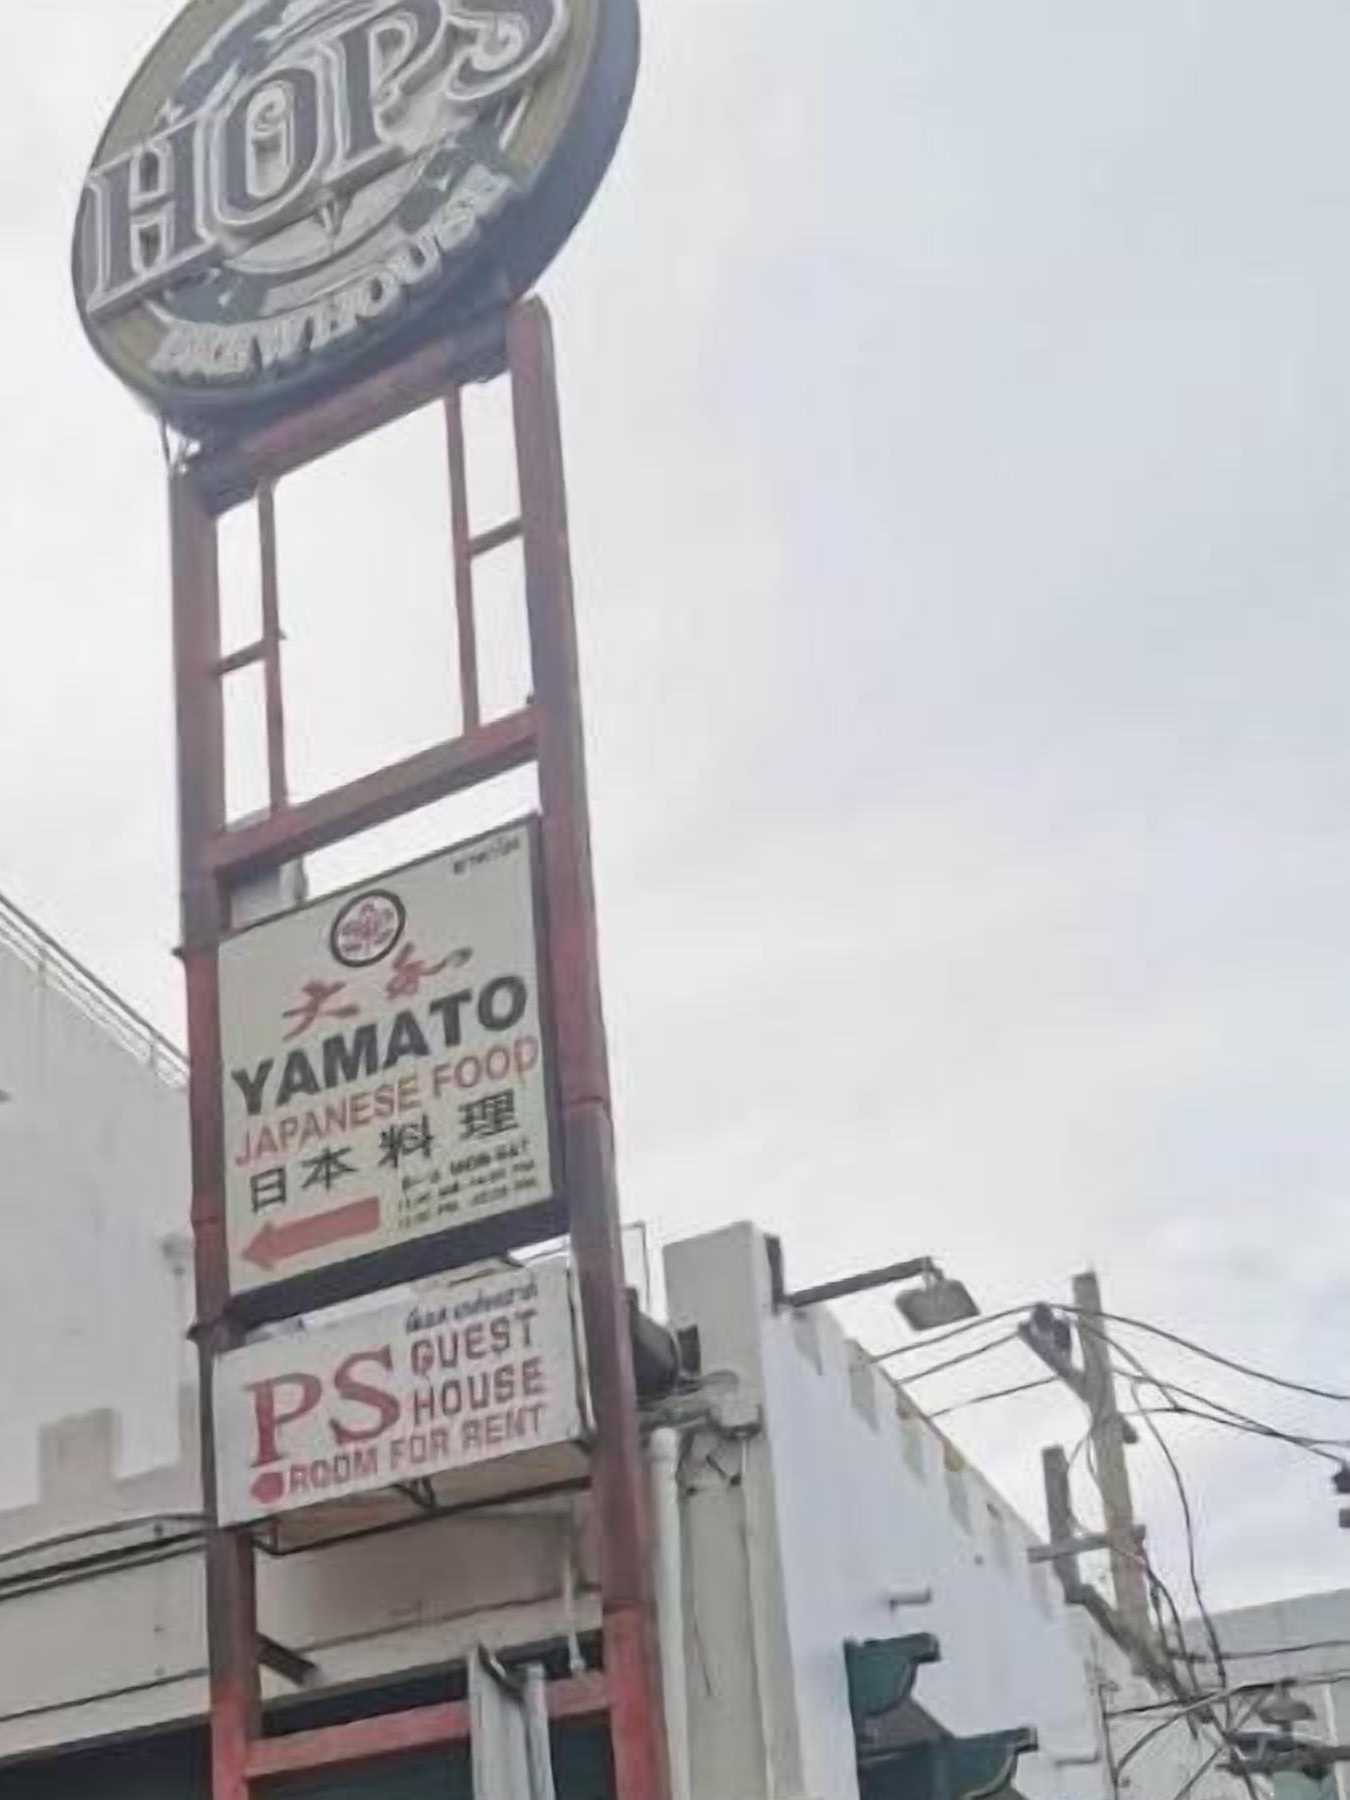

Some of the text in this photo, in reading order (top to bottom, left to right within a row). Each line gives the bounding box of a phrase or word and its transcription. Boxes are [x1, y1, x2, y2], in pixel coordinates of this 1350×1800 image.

[82, 0, 568, 314] HOPS
[231, 975, 528, 1116] YAMATO
[235, 1036, 539, 1167] JAPANESE FOOD
[250, 1088, 519, 1213] 日本料理
[244, 1309, 538, 1468] PS GUEST
[288, 1404, 546, 1496] ROOM FOR RENT
[413, 1356, 547, 1427] HOUSE
